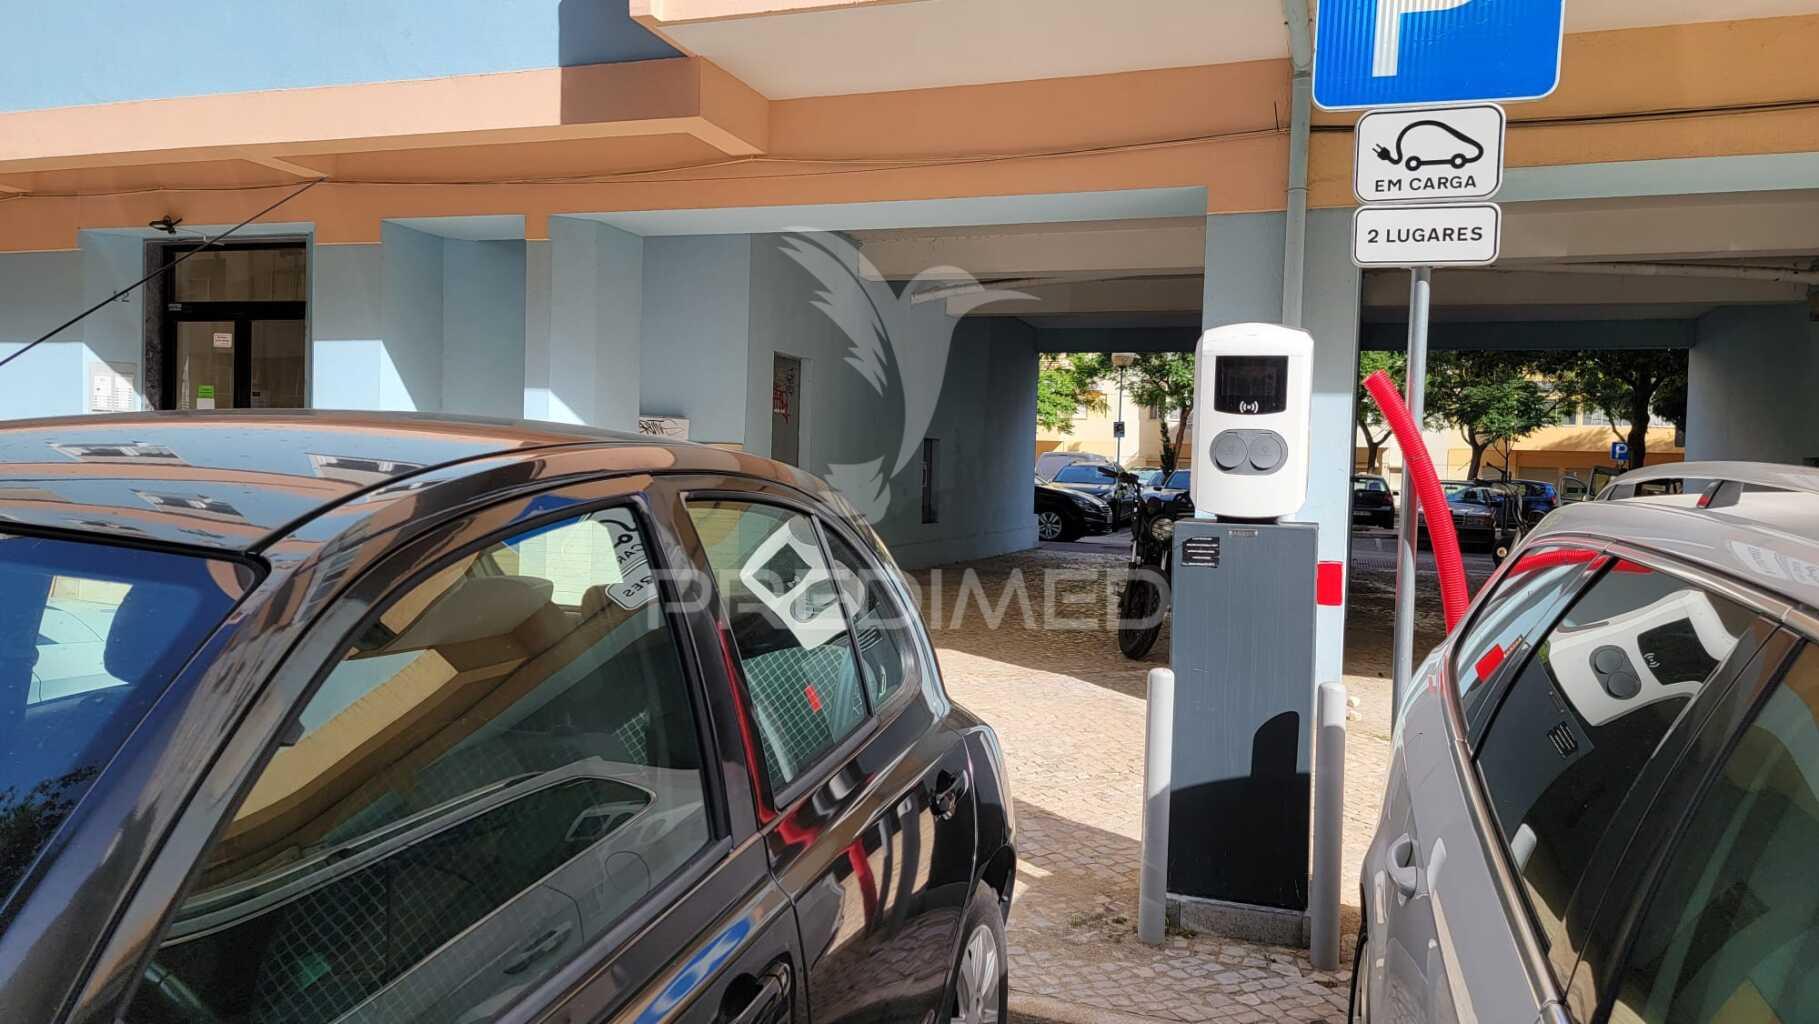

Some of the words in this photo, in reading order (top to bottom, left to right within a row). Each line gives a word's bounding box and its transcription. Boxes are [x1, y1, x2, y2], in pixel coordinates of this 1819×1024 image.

[1375, 178, 1402, 192] EM
[1409, 175, 1476, 190] CARGA
[1367, 229, 1379, 243] 2
[1386, 227, 1482, 243] LUGARES
[1615, 443, 1628, 459] P
